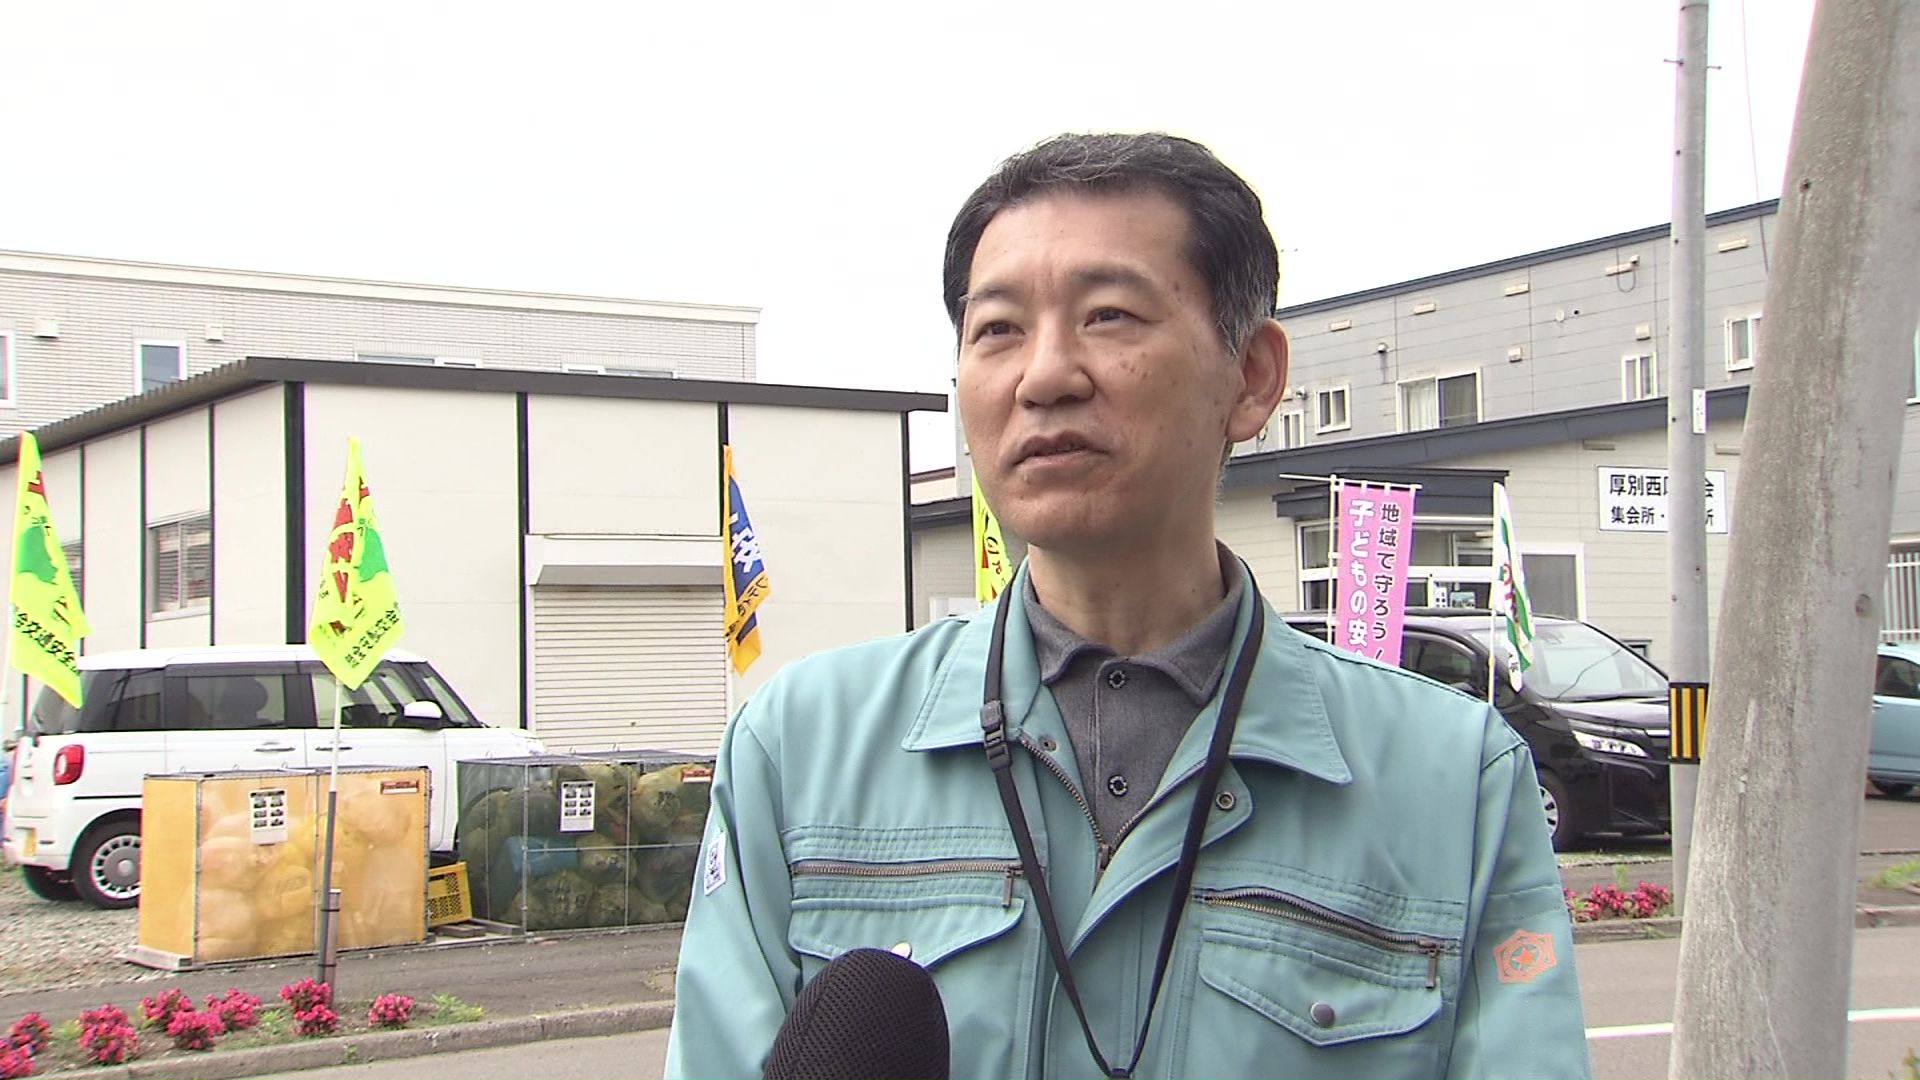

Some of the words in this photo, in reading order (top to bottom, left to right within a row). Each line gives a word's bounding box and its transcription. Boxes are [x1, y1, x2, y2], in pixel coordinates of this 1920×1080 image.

[1610, 474, 1714, 498] 厚別西会
[1348, 500, 1375, 659] 子どもの安
